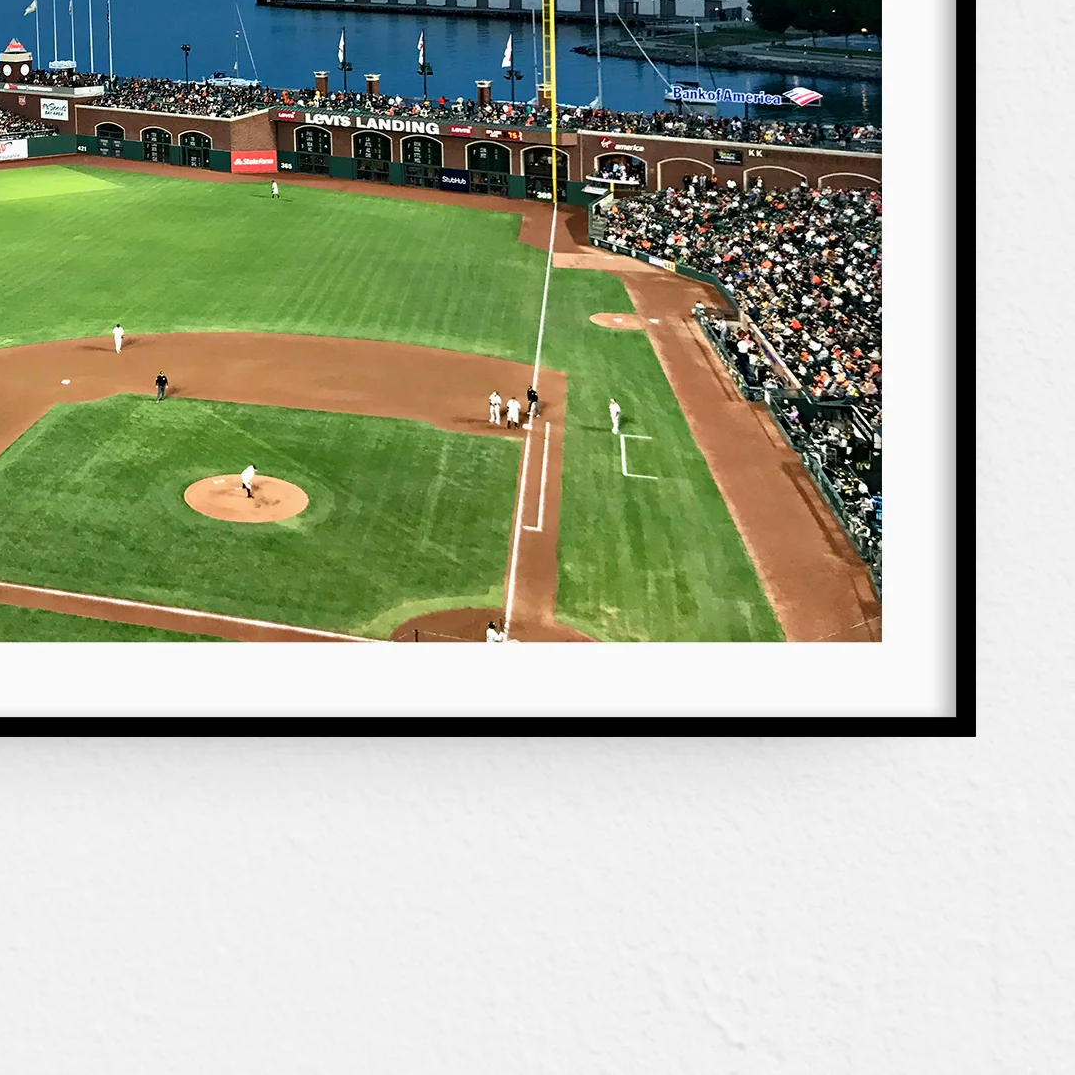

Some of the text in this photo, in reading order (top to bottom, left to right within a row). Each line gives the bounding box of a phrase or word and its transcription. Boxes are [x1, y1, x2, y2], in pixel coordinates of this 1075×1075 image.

[673, 86, 782, 105] Bank of America
[356, 116, 440, 135] LANDING
[508, 131, 518, 139] 75
[614, 144, 645, 152] america
[281, 162, 293, 170] 365
[441, 175, 467, 185] StubHub
[536, 191, 552, 200] 309
